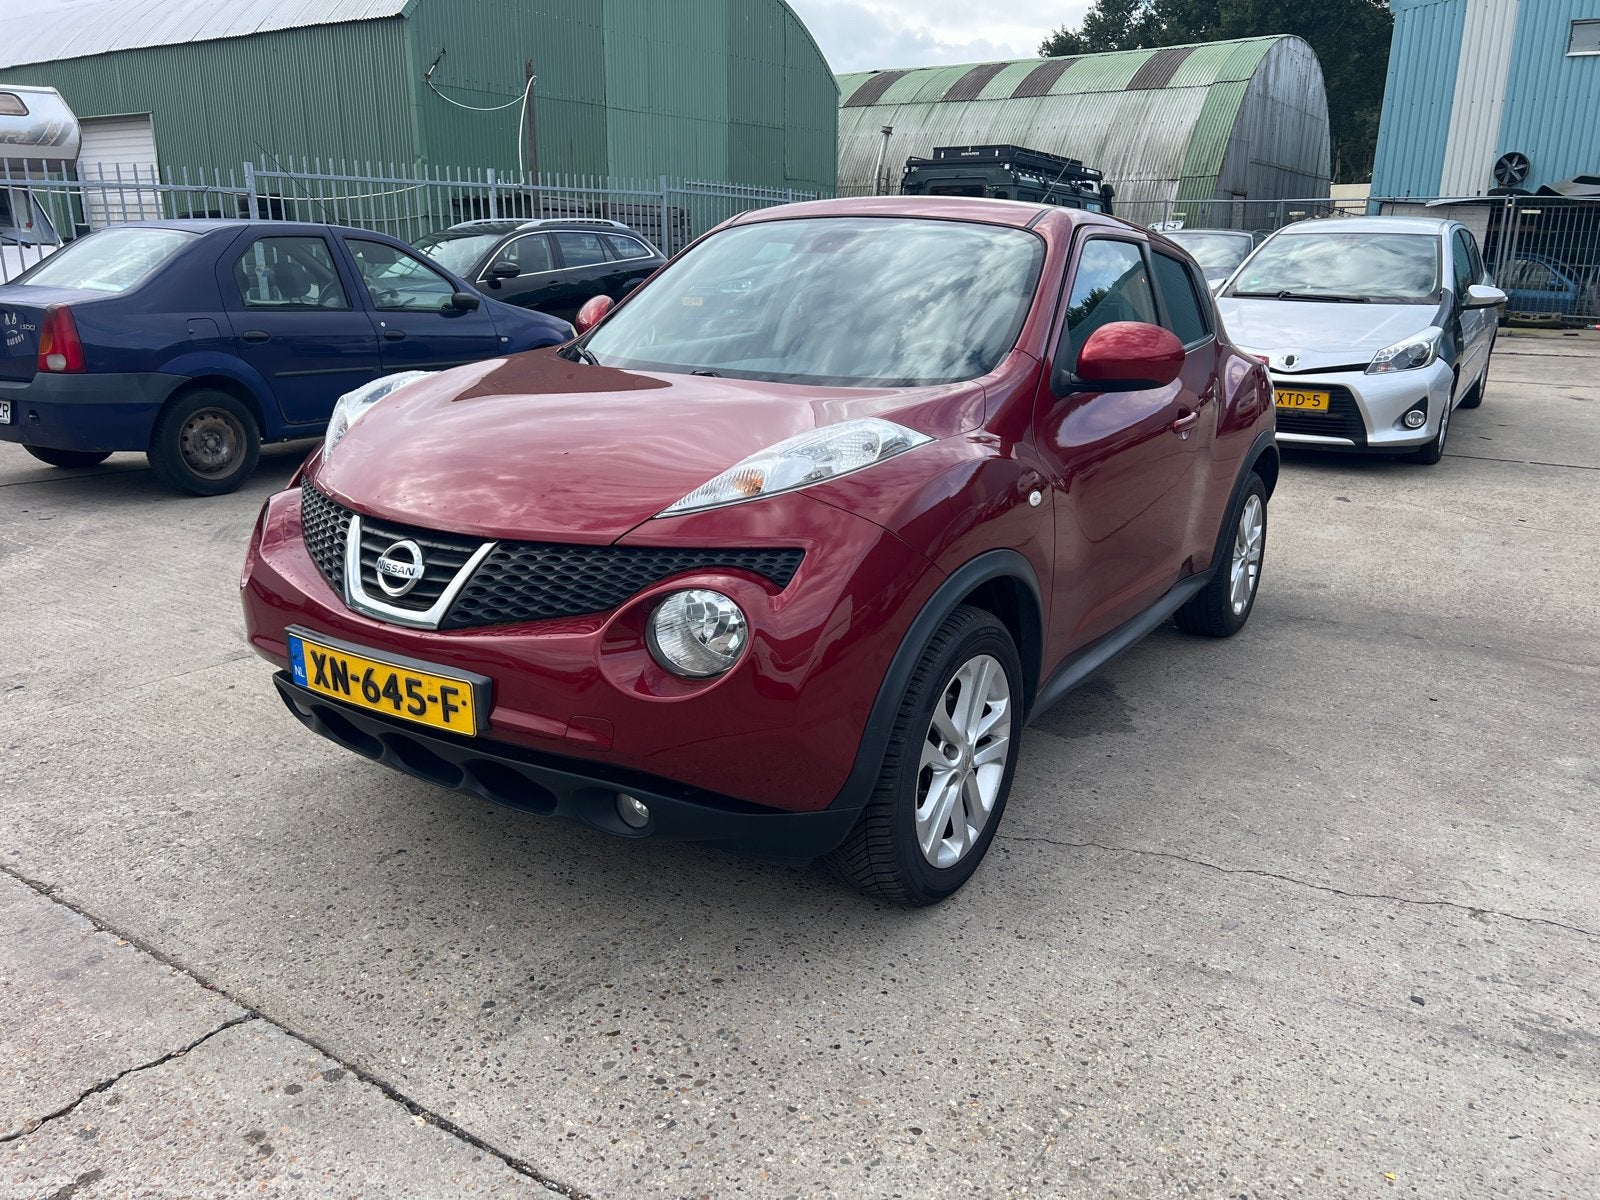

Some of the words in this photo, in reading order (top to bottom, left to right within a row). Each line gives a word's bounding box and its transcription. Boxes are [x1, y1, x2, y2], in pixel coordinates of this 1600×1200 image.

[1276, 391, 1321, 407] XTD-5
[376, 559, 416, 576] NISSAN
[294, 664, 306, 678] NL
[310, 650, 459, 722] XN-645-F
